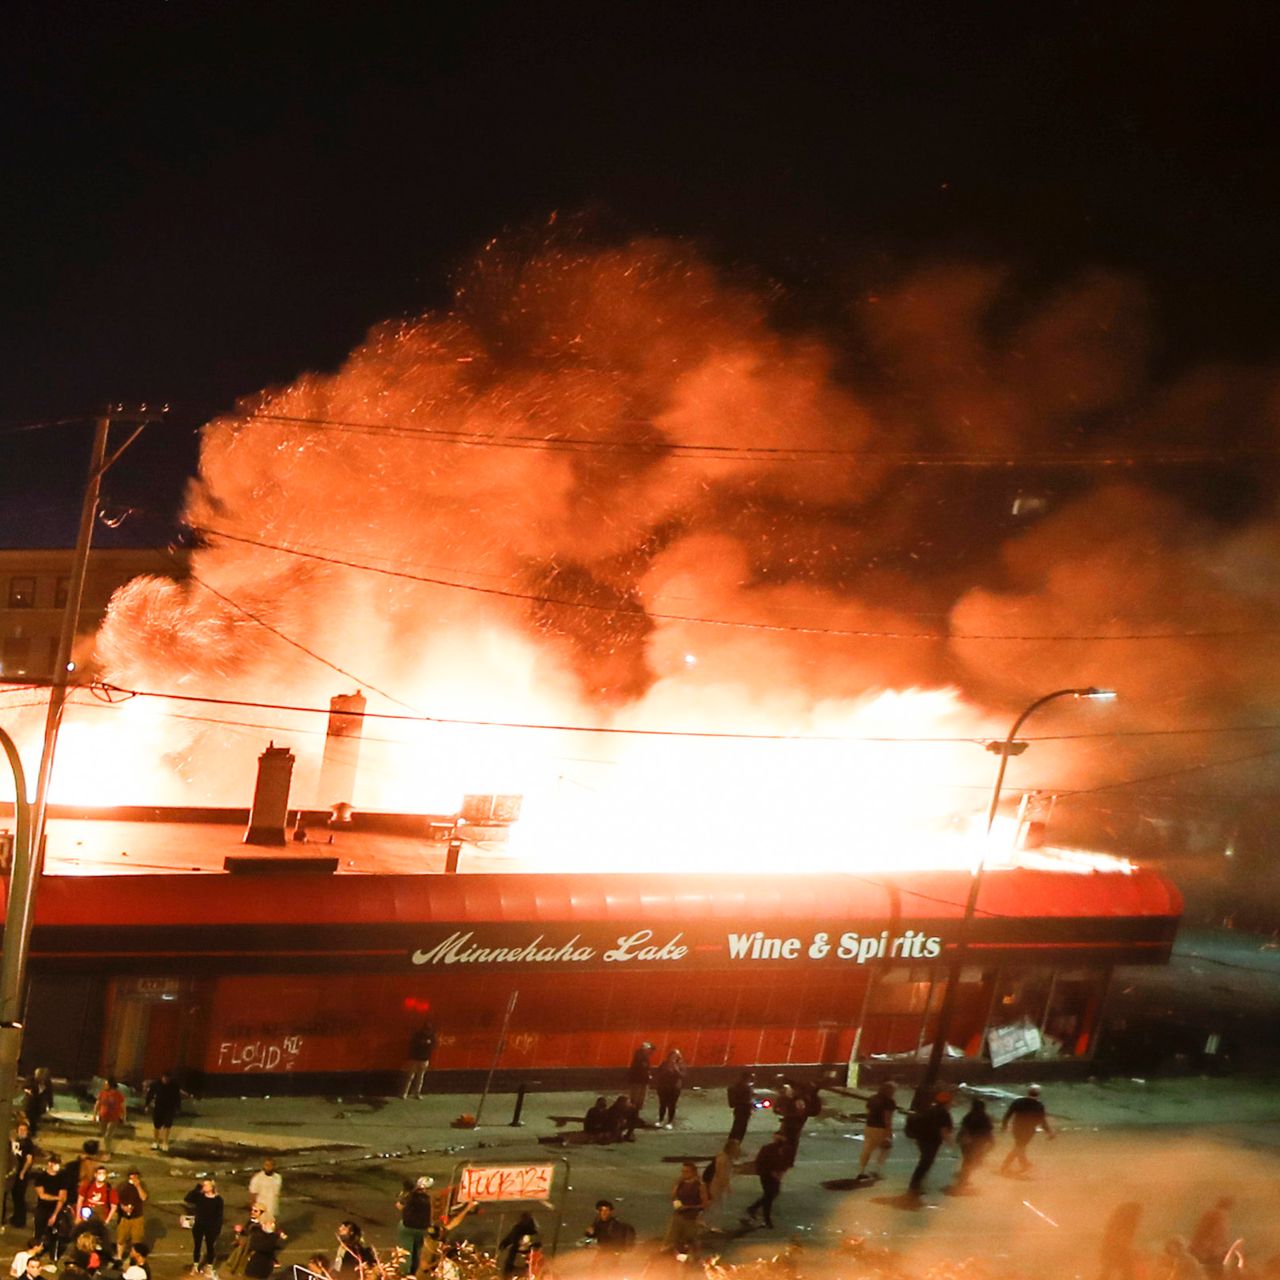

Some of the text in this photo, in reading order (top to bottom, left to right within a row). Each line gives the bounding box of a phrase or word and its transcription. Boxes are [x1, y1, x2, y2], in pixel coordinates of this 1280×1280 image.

[411, 929, 941, 966] Minnehaha Lake Wine & Spirits
[217, 1041, 281, 1071] FLOYD
[465, 1168, 515, 1199] FUCK
